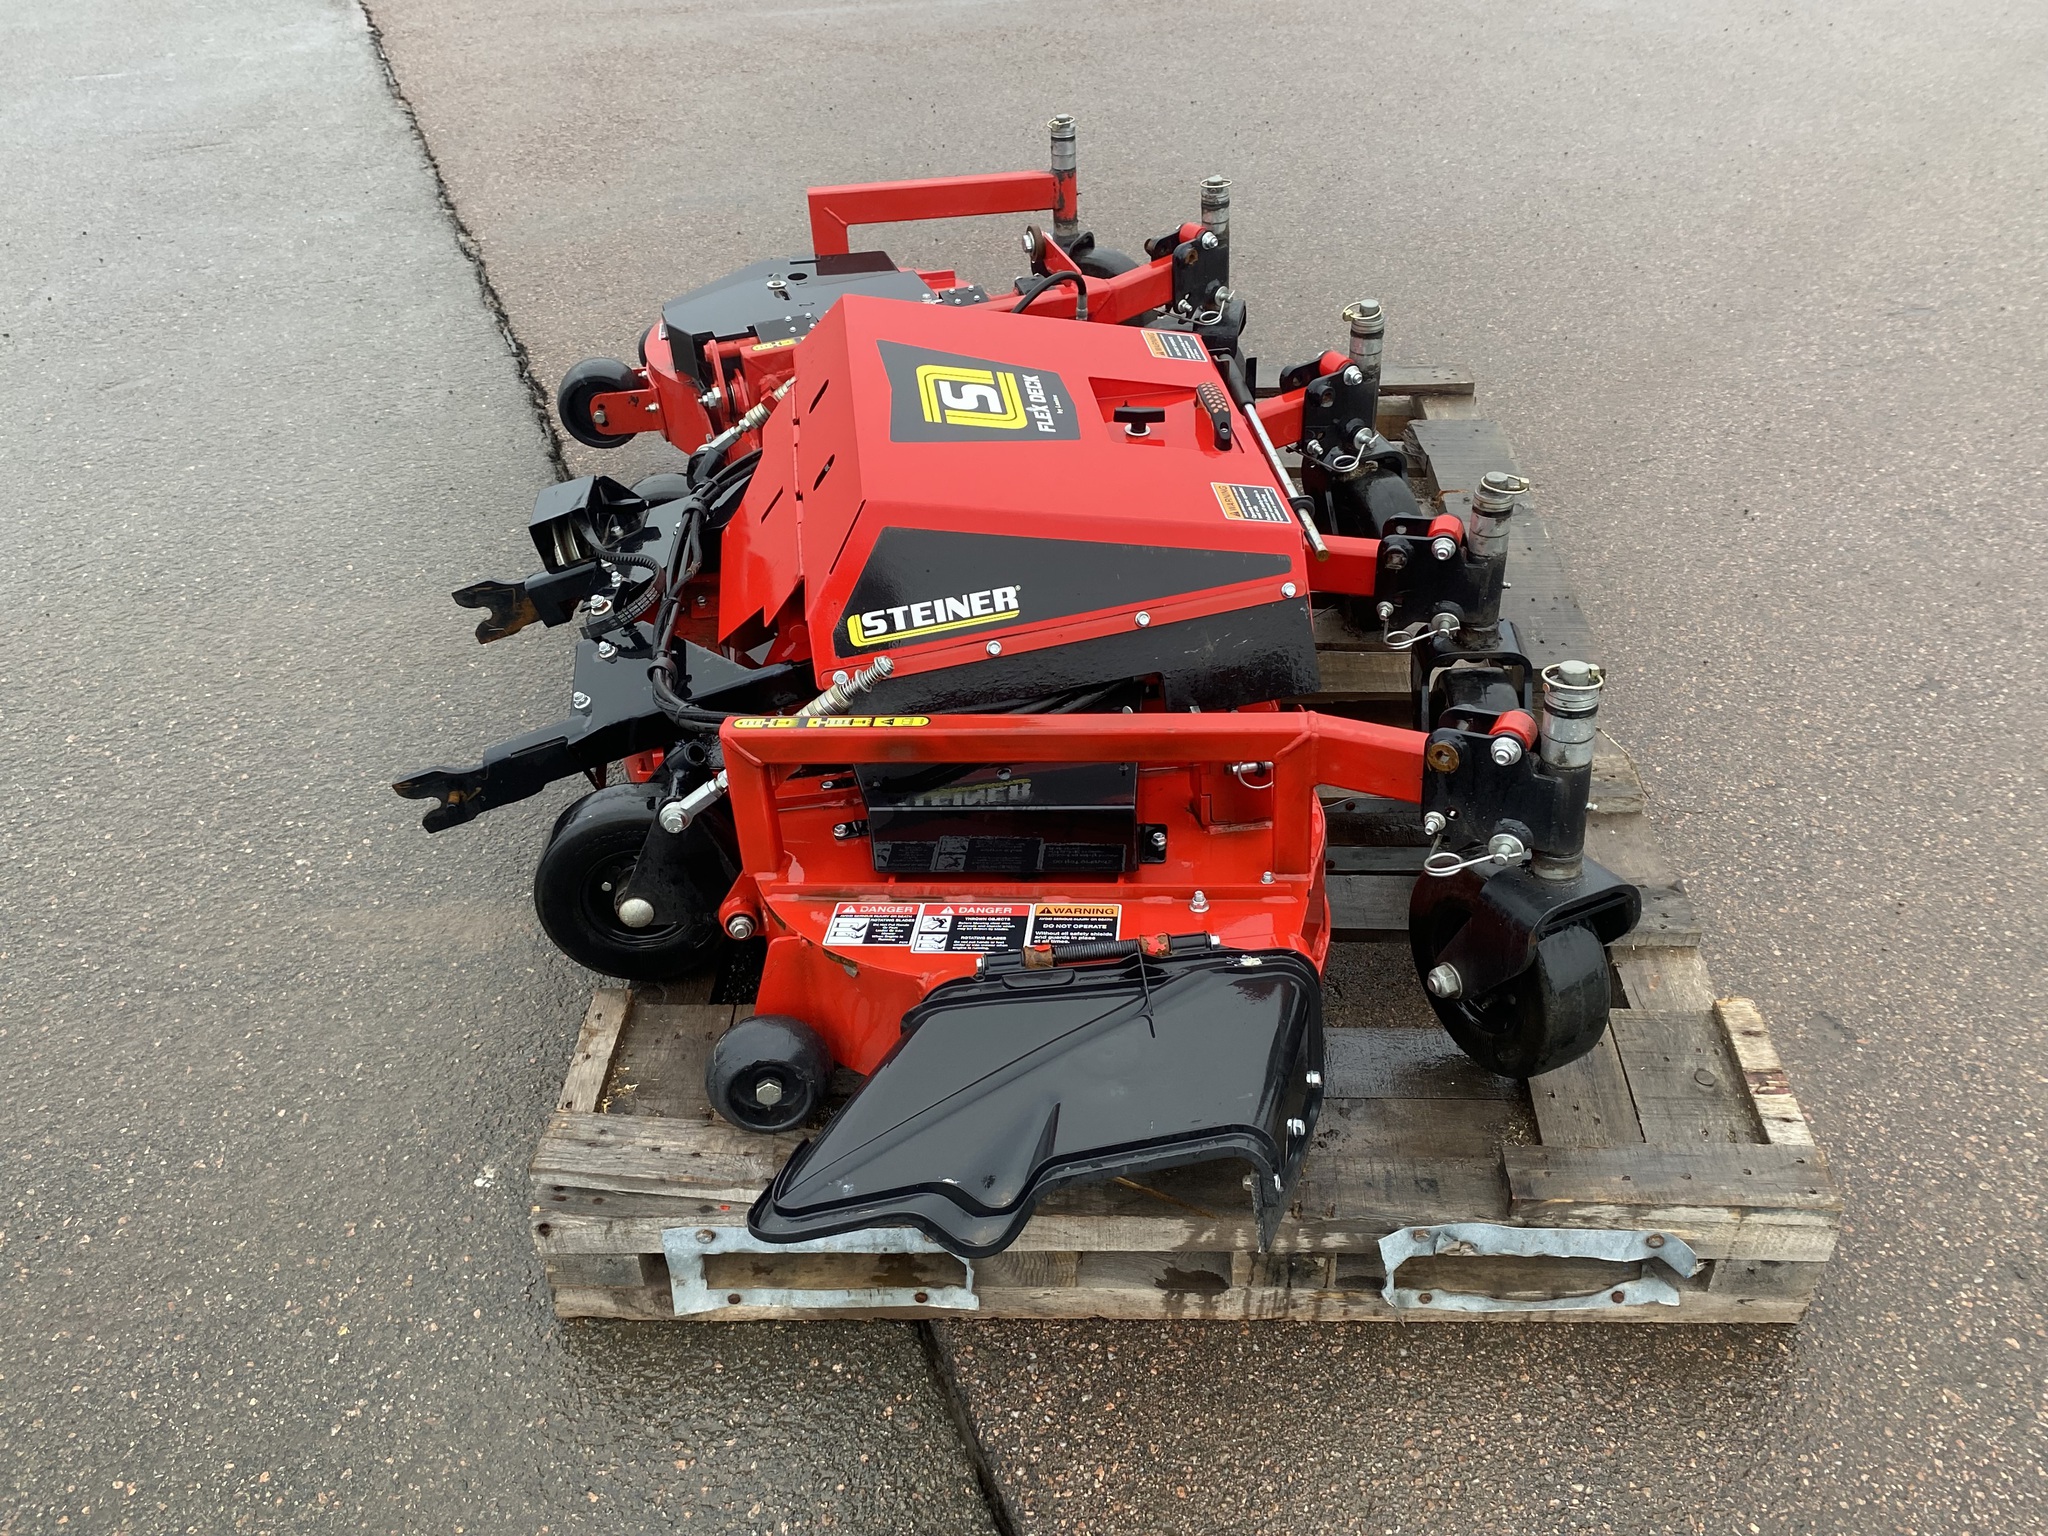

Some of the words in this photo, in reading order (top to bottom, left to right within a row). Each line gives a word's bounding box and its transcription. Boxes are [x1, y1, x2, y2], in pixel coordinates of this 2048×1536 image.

[1022, 374, 1047, 403] DECK
[1026, 404, 1057, 433] FLEX
[1218, 485, 1238, 514] WARNING
